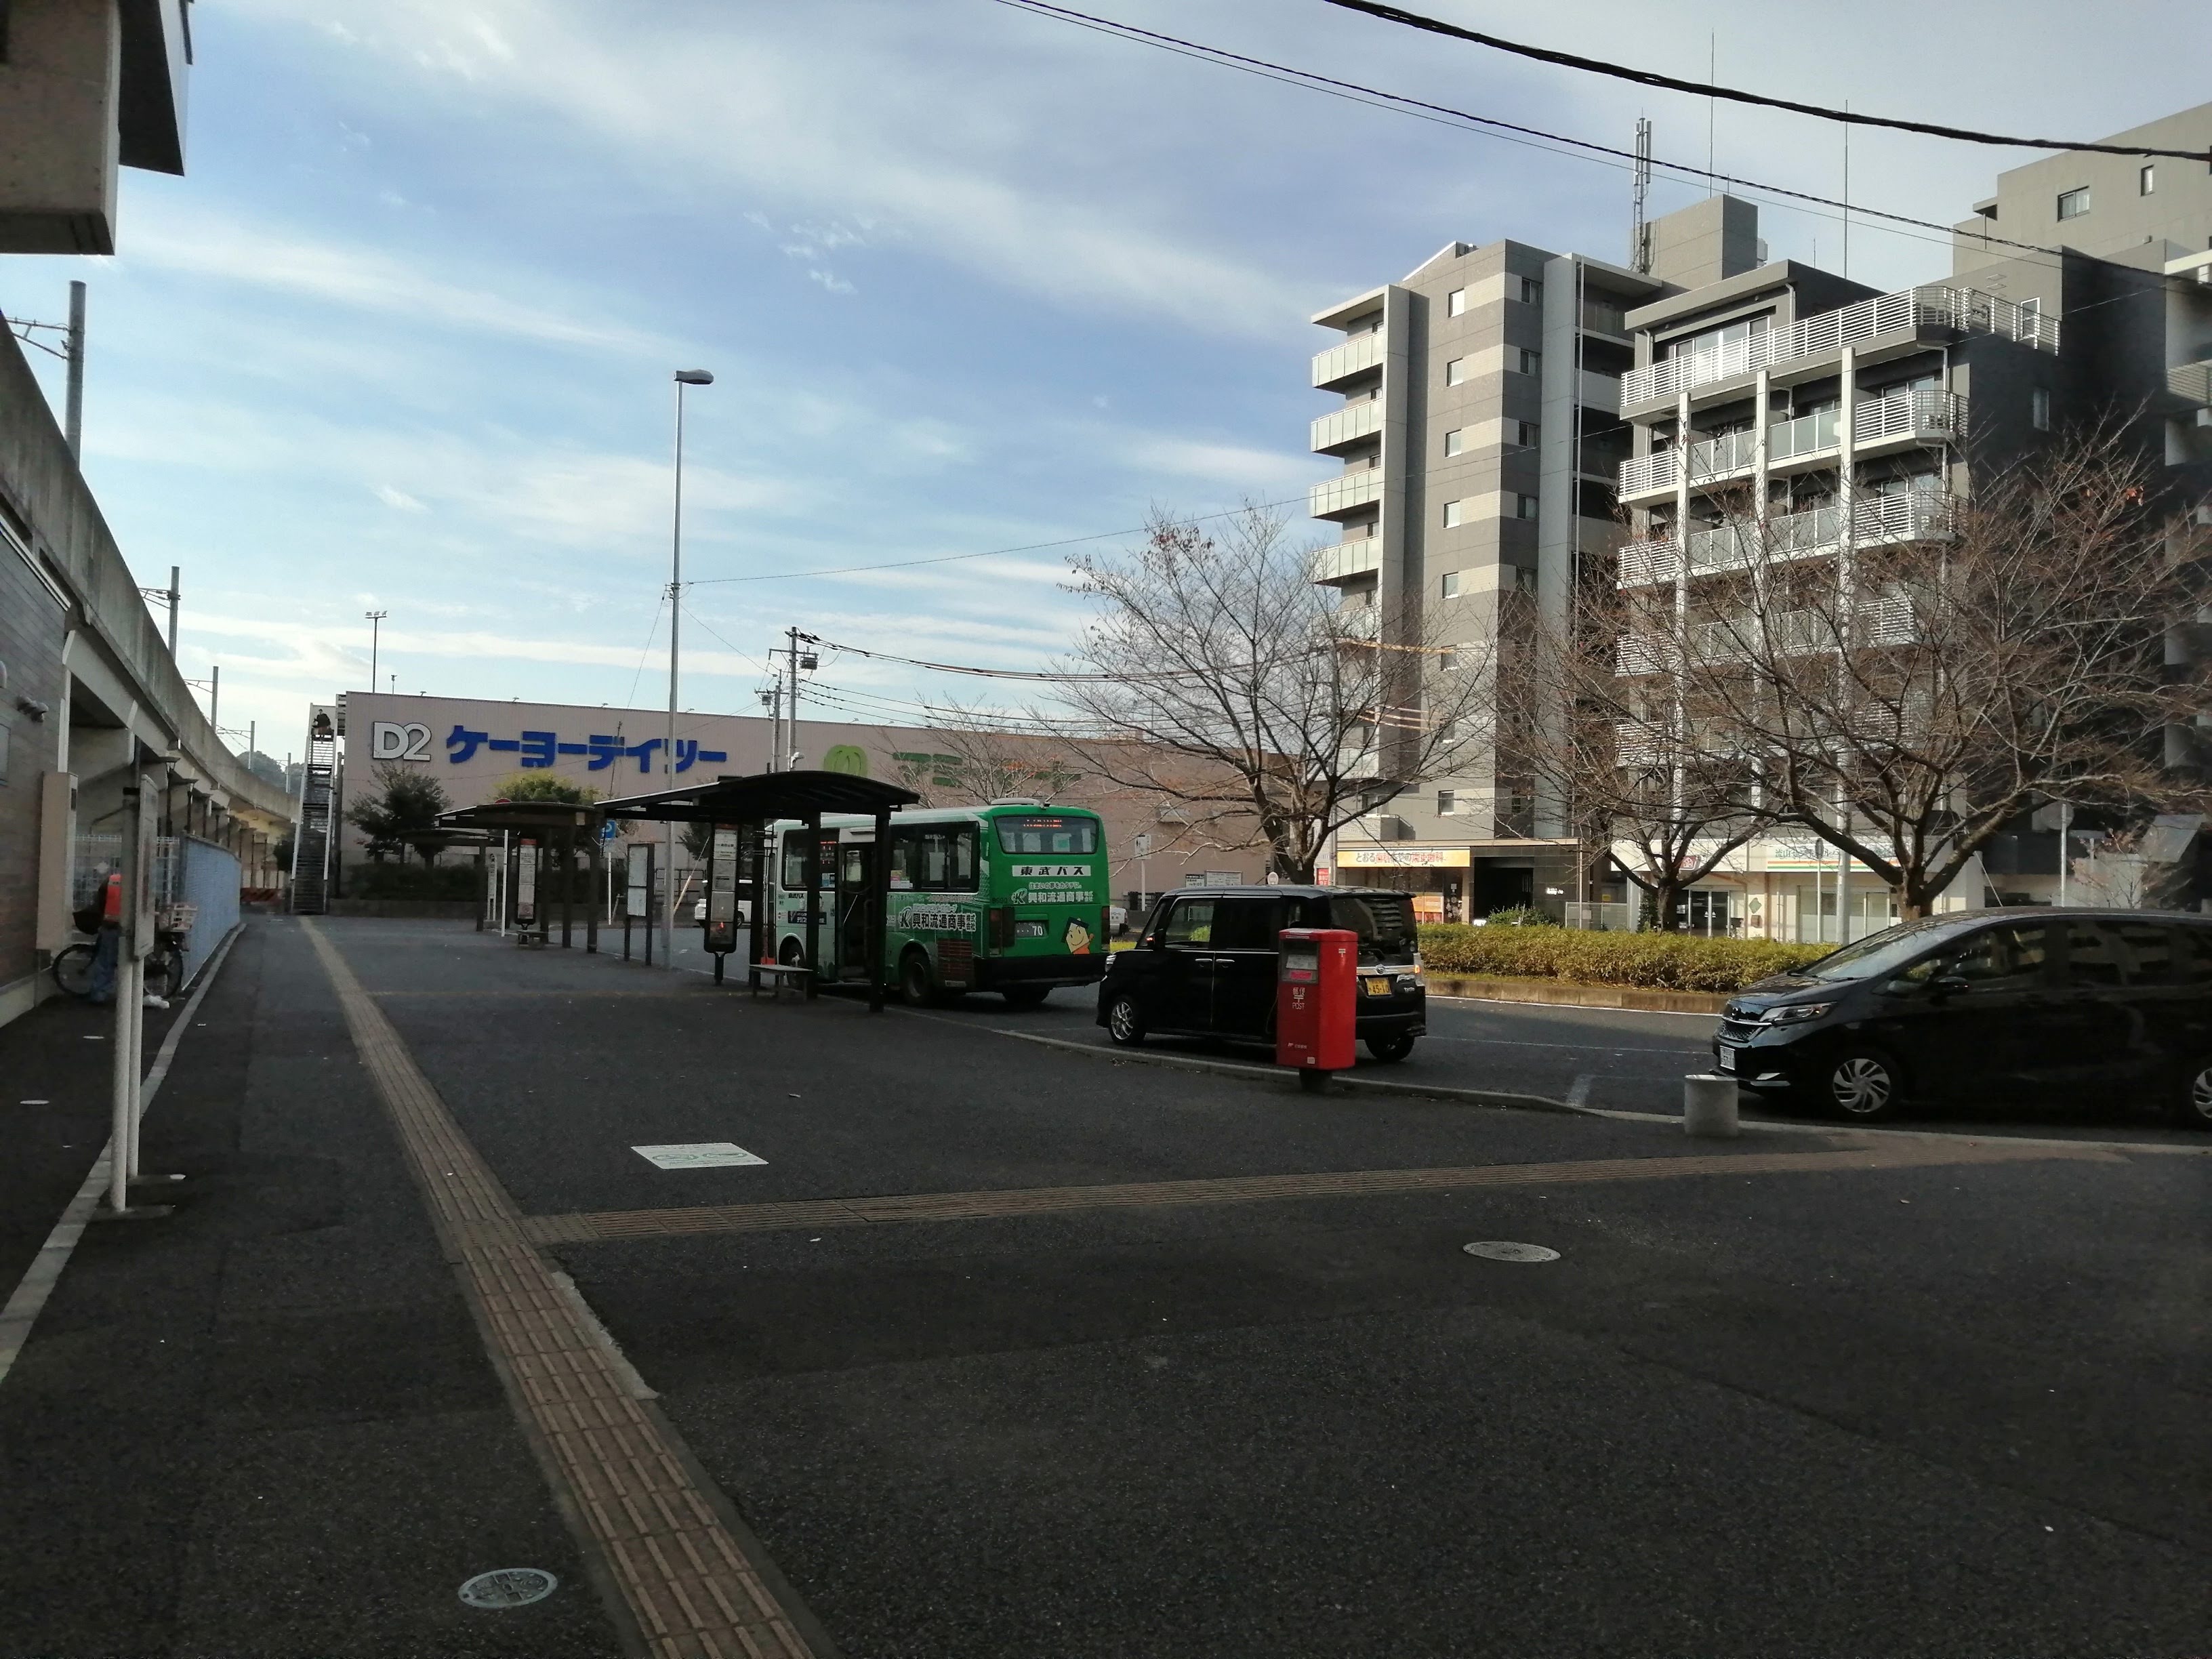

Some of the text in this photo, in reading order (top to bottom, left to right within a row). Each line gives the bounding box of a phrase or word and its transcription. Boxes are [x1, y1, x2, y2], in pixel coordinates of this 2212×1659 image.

[372, 721, 432, 761] D2
[446, 725, 727, 773] ケーヨーデイツー
[1021, 866, 1084, 876] 東武バス
